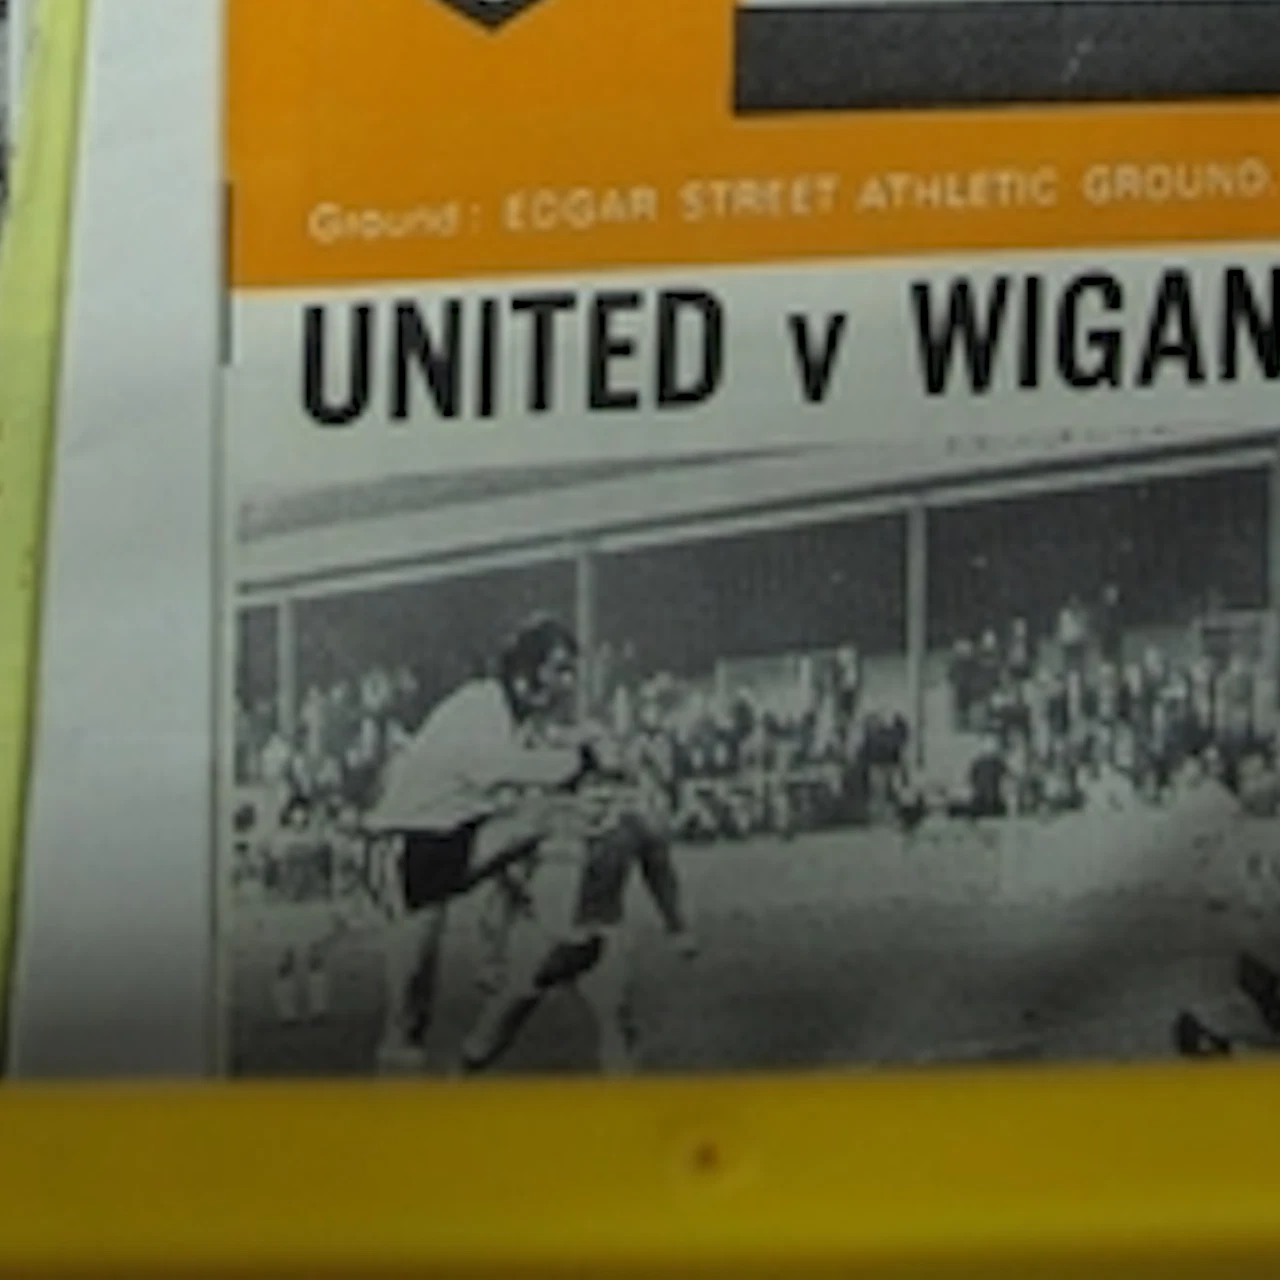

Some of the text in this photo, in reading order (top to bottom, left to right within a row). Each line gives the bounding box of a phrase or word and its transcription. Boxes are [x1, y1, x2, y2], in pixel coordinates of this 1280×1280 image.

[504, 186, 658, 231] EDGAR
[681, 176, 836, 221] STREET
[857, 168, 1056, 210] ATHLETIC
[303, 290, 723, 426] UNITED
[790, 314, 845, 403] v
